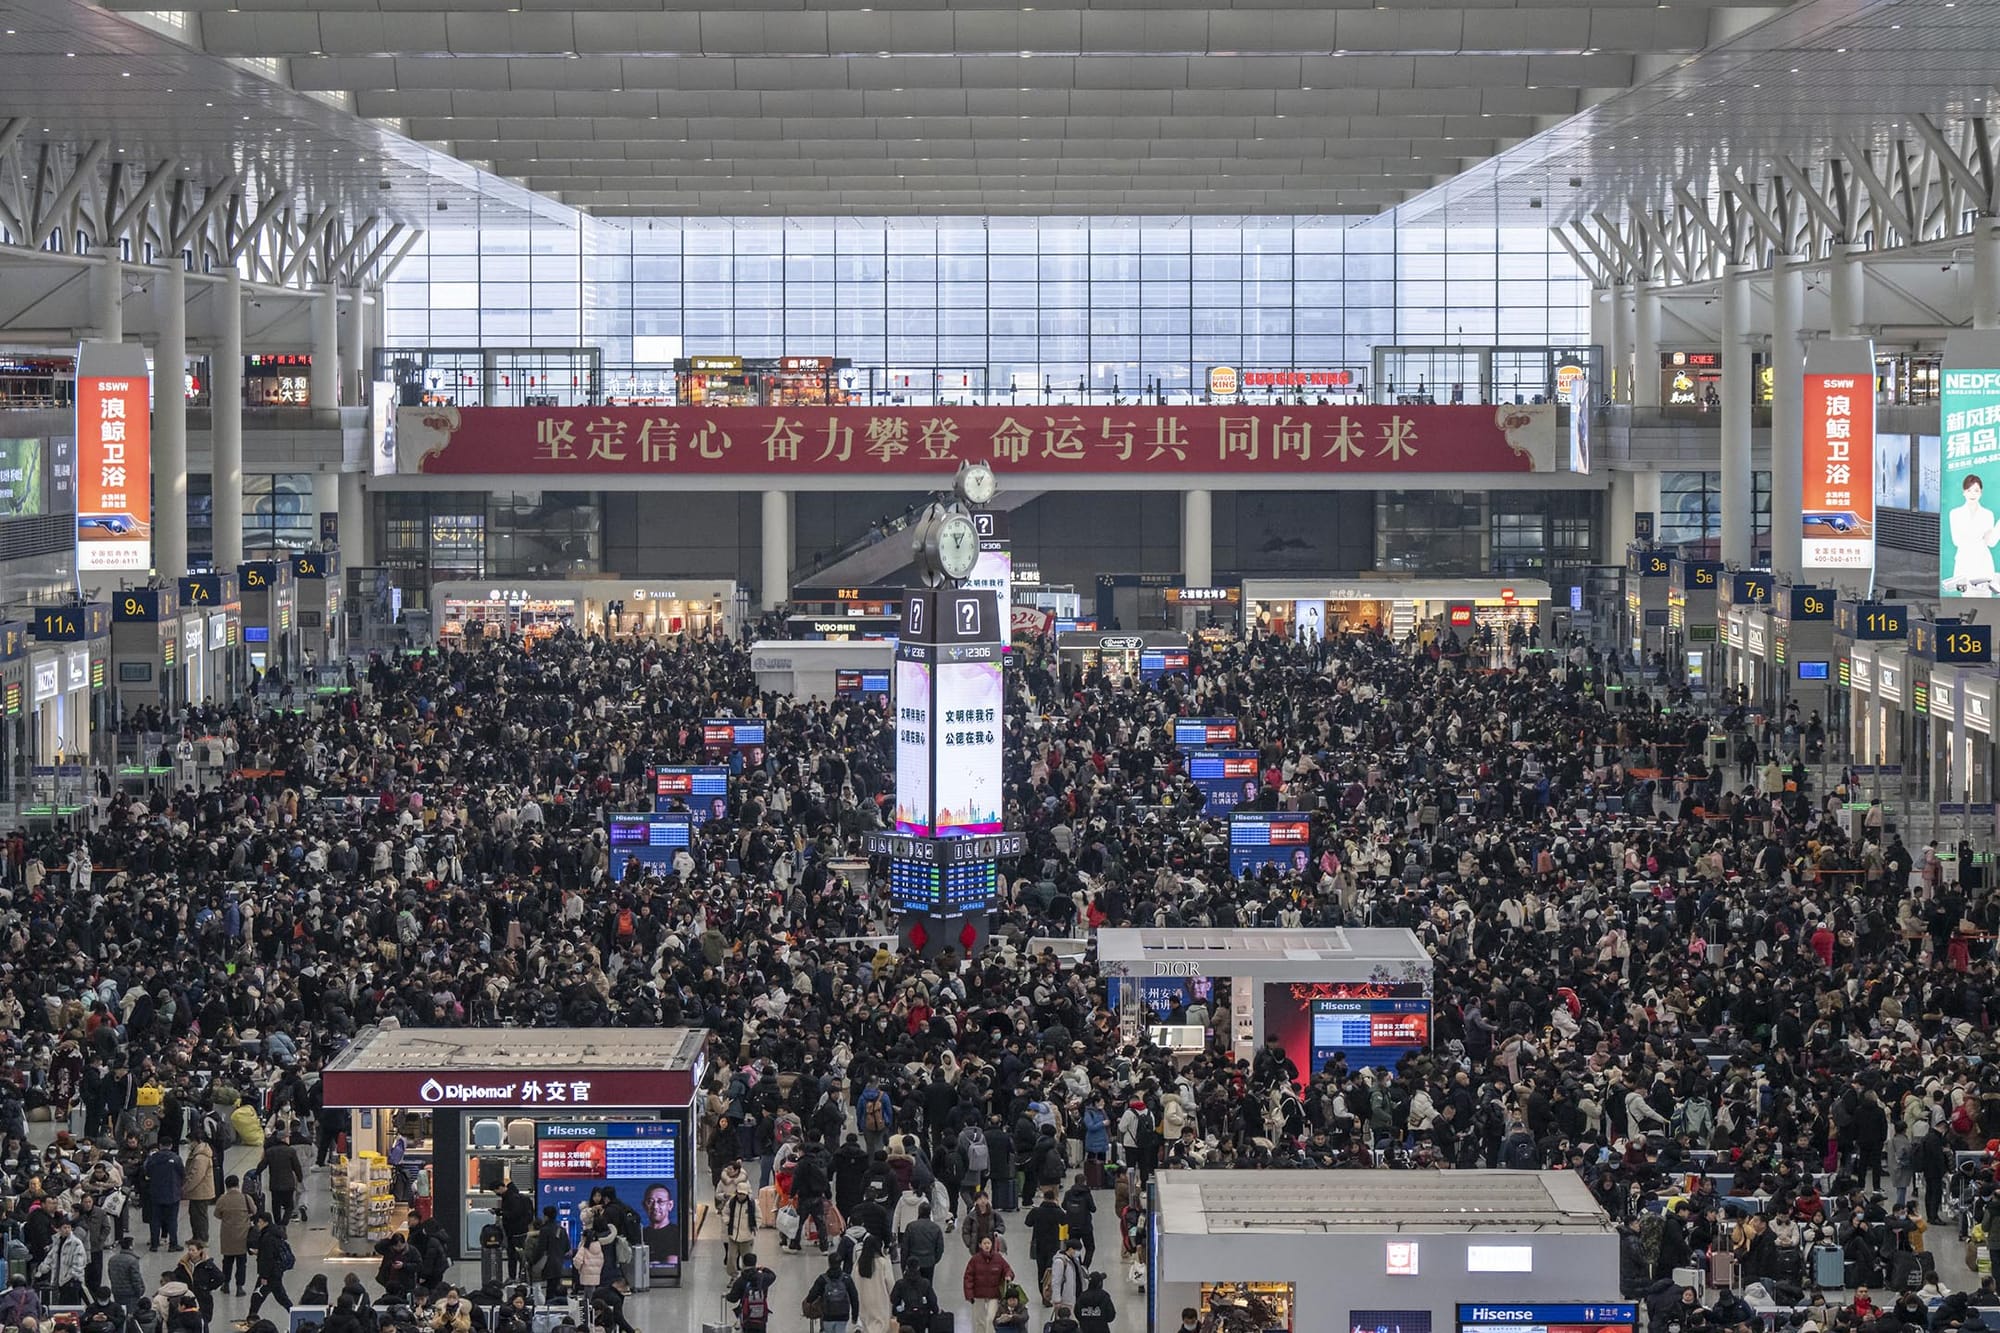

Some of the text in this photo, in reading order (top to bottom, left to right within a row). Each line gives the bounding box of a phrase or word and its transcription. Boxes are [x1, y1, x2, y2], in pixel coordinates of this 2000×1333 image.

[282, 377, 306, 389] 永和
[1245, 372, 1349, 385] BURGER KING
[1824, 380, 1854, 388] SSWW
[98, 382, 129, 391] SSWW
[282, 390, 306, 402] 大王
[101, 398, 127, 488] 浪鲸卫浴
[533, 416, 1419, 463] 坚定信心 奋力攀登 命运与共 同向未来
[1825, 395, 1852, 485] 浪鲸卫浴
[299, 560, 315, 573] 3A
[1651, 558, 1667, 571] 3B
[248, 571, 265, 585] 5A
[1696, 569, 1713, 583] 5B
[190, 584, 209, 600] 7A
[1745, 582, 1765, 598] 7B
[125, 598, 145, 615] 9A
[1804, 597, 1825, 614] 9B
[1451, 611, 1470, 620] LEGO
[1867, 614, 1898, 631] 11B
[44, 616, 75, 633] 11A
[1946, 634, 1982, 653] 13B
[965, 648, 991, 657] 12306
[901, 708, 925, 721] 文明伴我行
[945, 708, 994, 722] 文明伴我行
[901, 730, 925, 744] 公德在我心
[945, 730, 994, 745] 公德在我心
[1153, 961, 1200, 976] DIOR
[1320, 1001, 1361, 1010] Hisense
[445, 1081, 591, 1102] Diplomat 外交官
[547, 1126, 597, 1135] Hisense
[1472, 1308, 1533, 1320] Hisense
